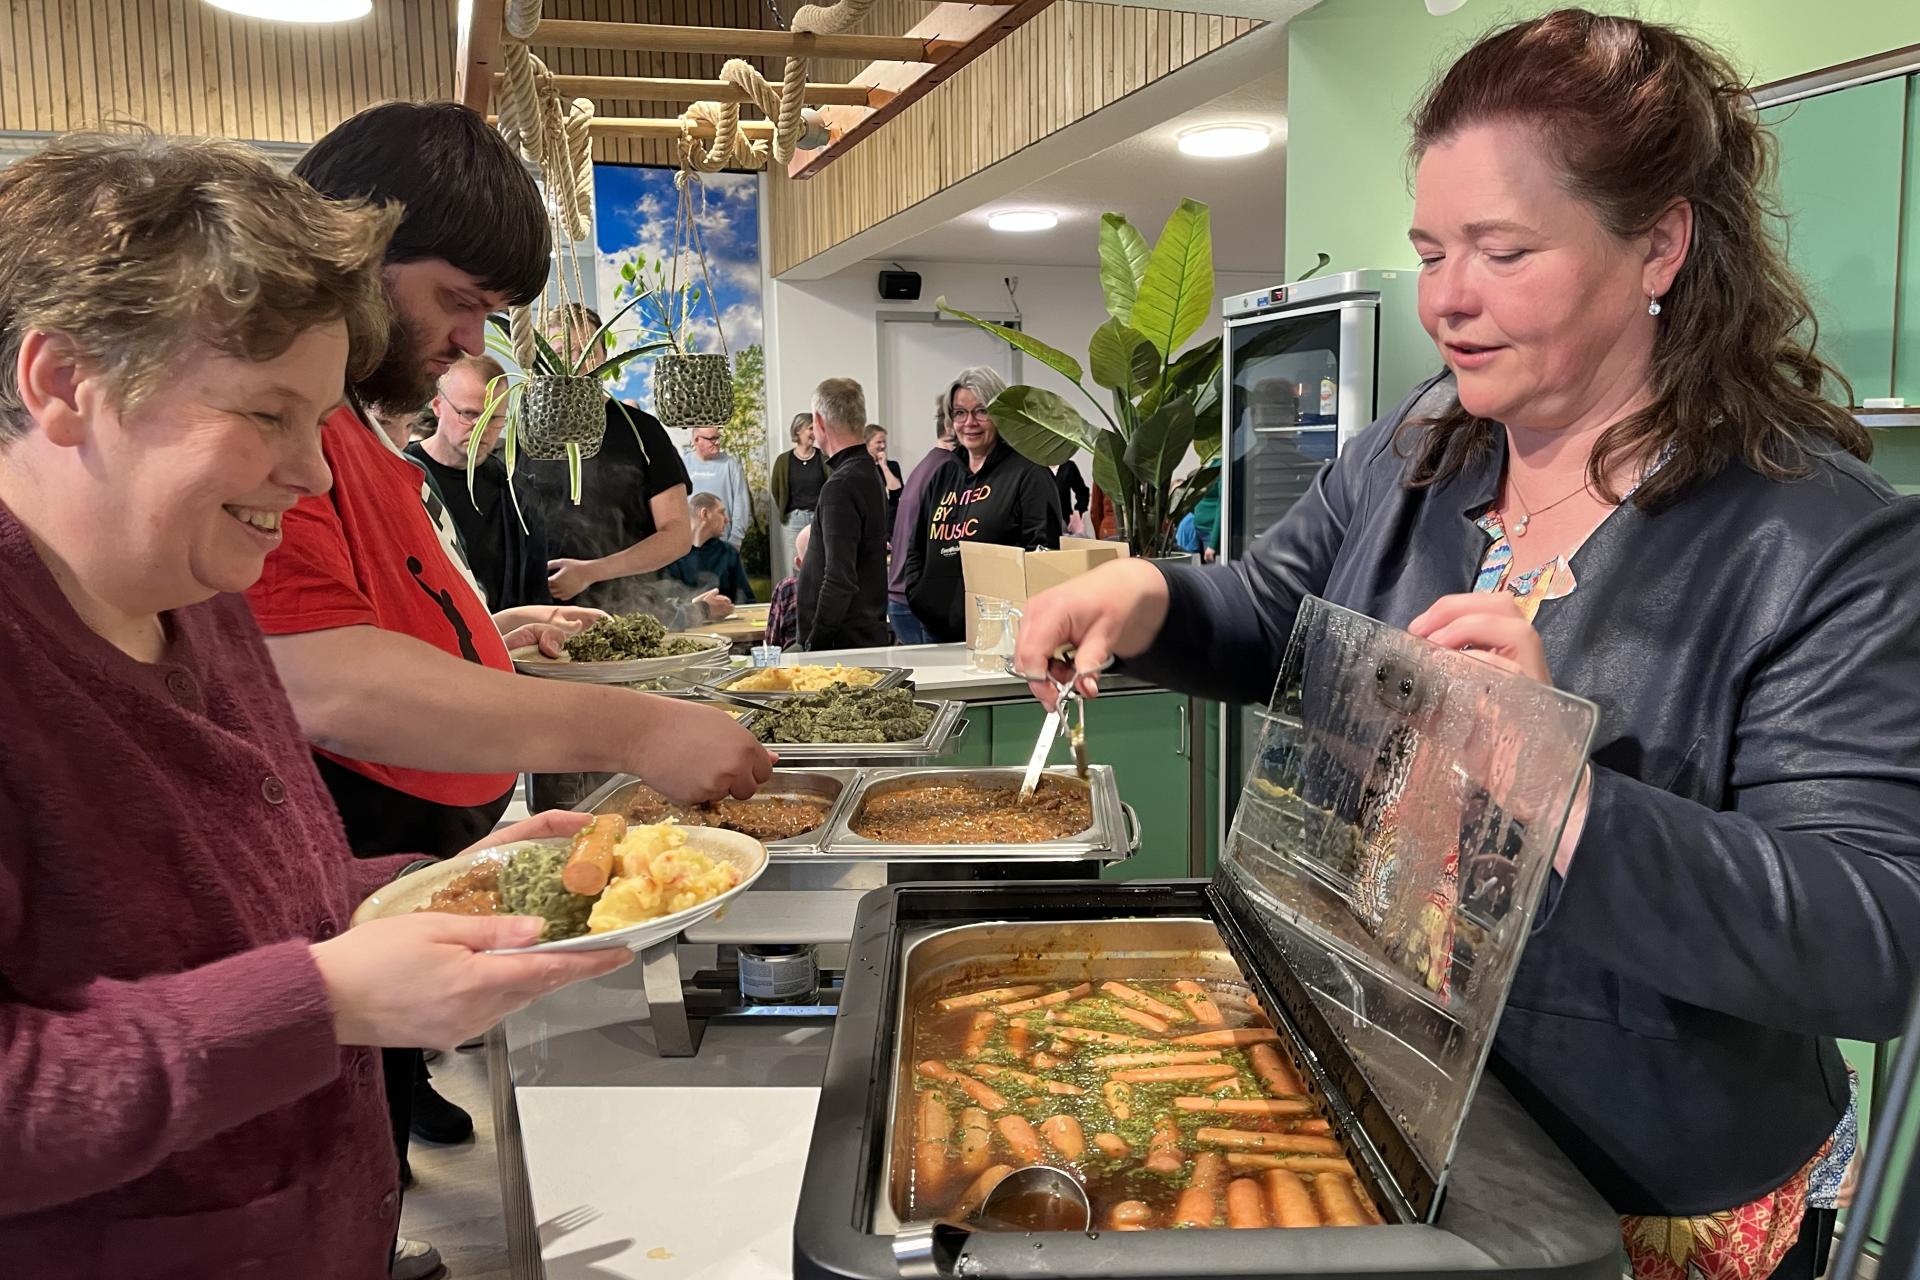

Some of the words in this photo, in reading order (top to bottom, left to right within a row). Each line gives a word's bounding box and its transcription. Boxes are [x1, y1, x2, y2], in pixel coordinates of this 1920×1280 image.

[940, 485, 991, 505] UNITED
[933, 506, 953, 521] BY
[929, 519, 979, 540] MUSIC
